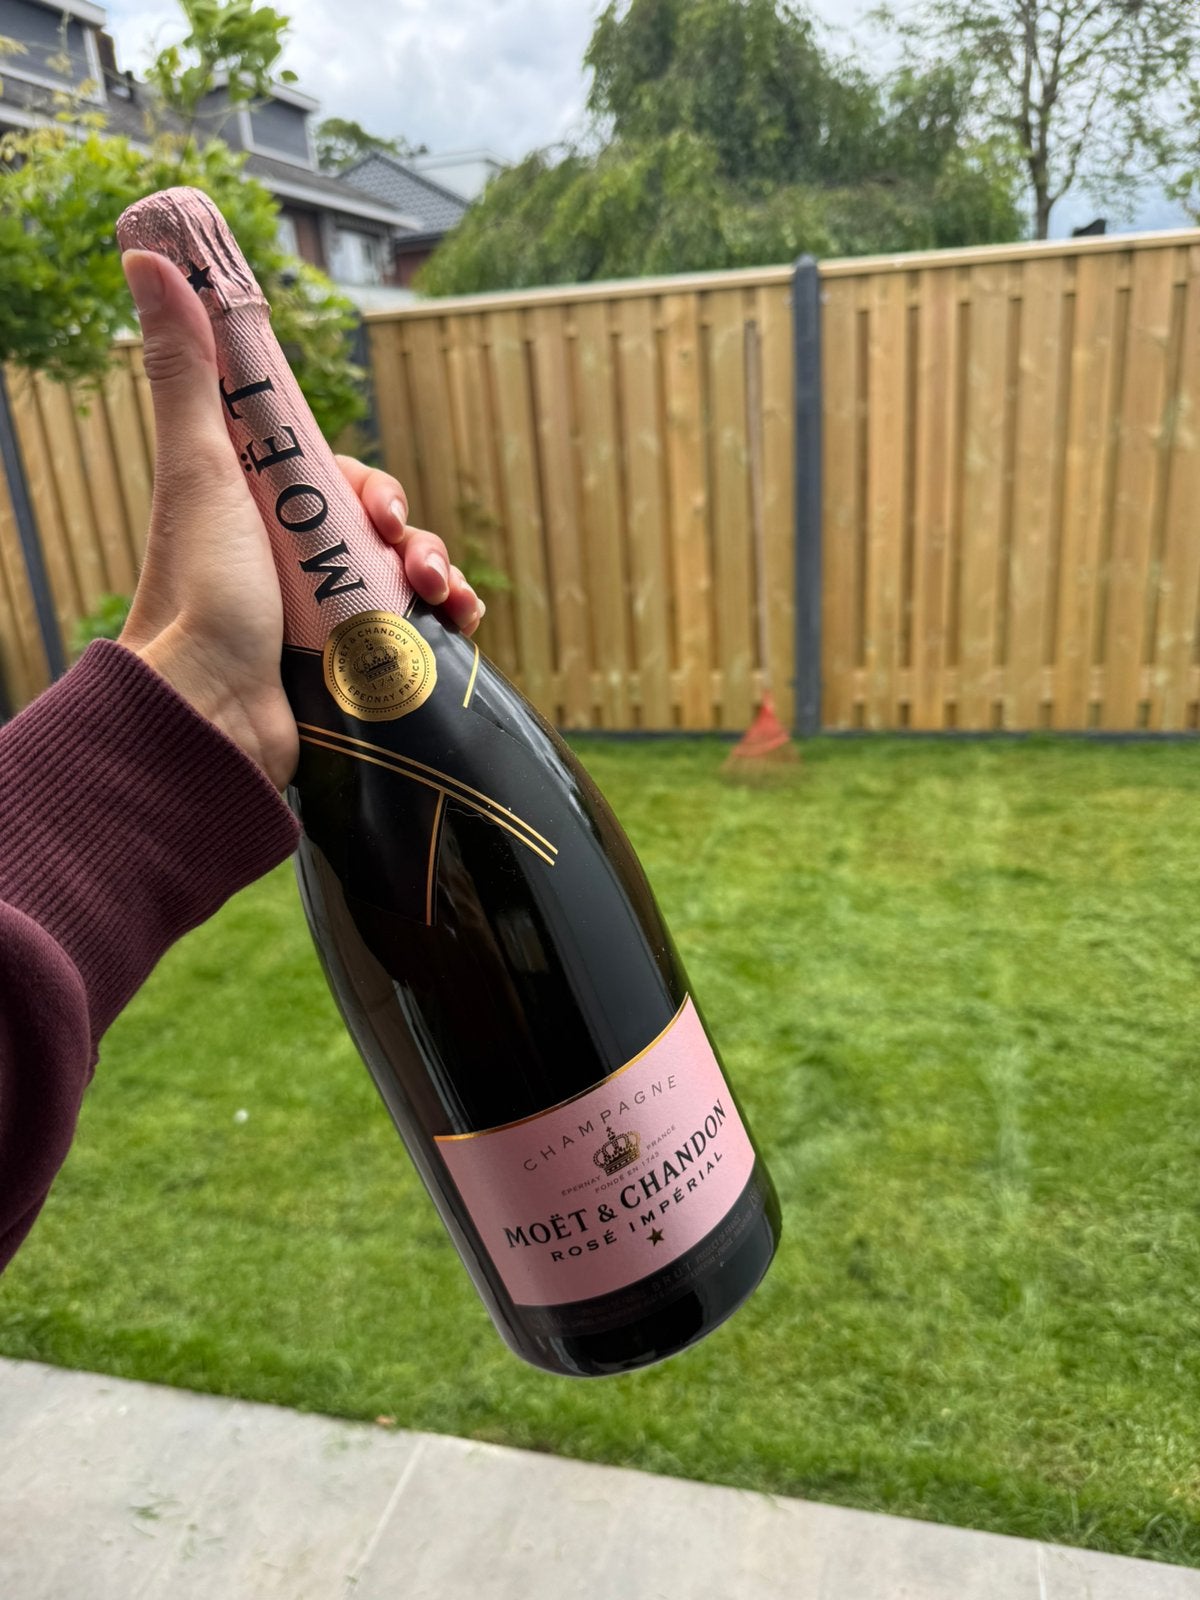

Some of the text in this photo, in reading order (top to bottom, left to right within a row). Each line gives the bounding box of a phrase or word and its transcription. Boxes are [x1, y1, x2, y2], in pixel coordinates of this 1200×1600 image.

[219, 376, 368, 605] MOËT
[357, 627, 408, 646] CHANDON
[398, 658, 420, 696] FRANCE
[523, 1074, 677, 1172] CHAMPAGNE
[646, 1124, 676, 1151] FRANCE
[502, 1208, 587, 1249] MOËT
[598, 1203, 618, 1224] &
[620, 1099, 727, 1210] CHANDON
[627, 1166, 639, 1177] EN
[551, 1151, 723, 1263] ROSÉ IMPÉRIAL
